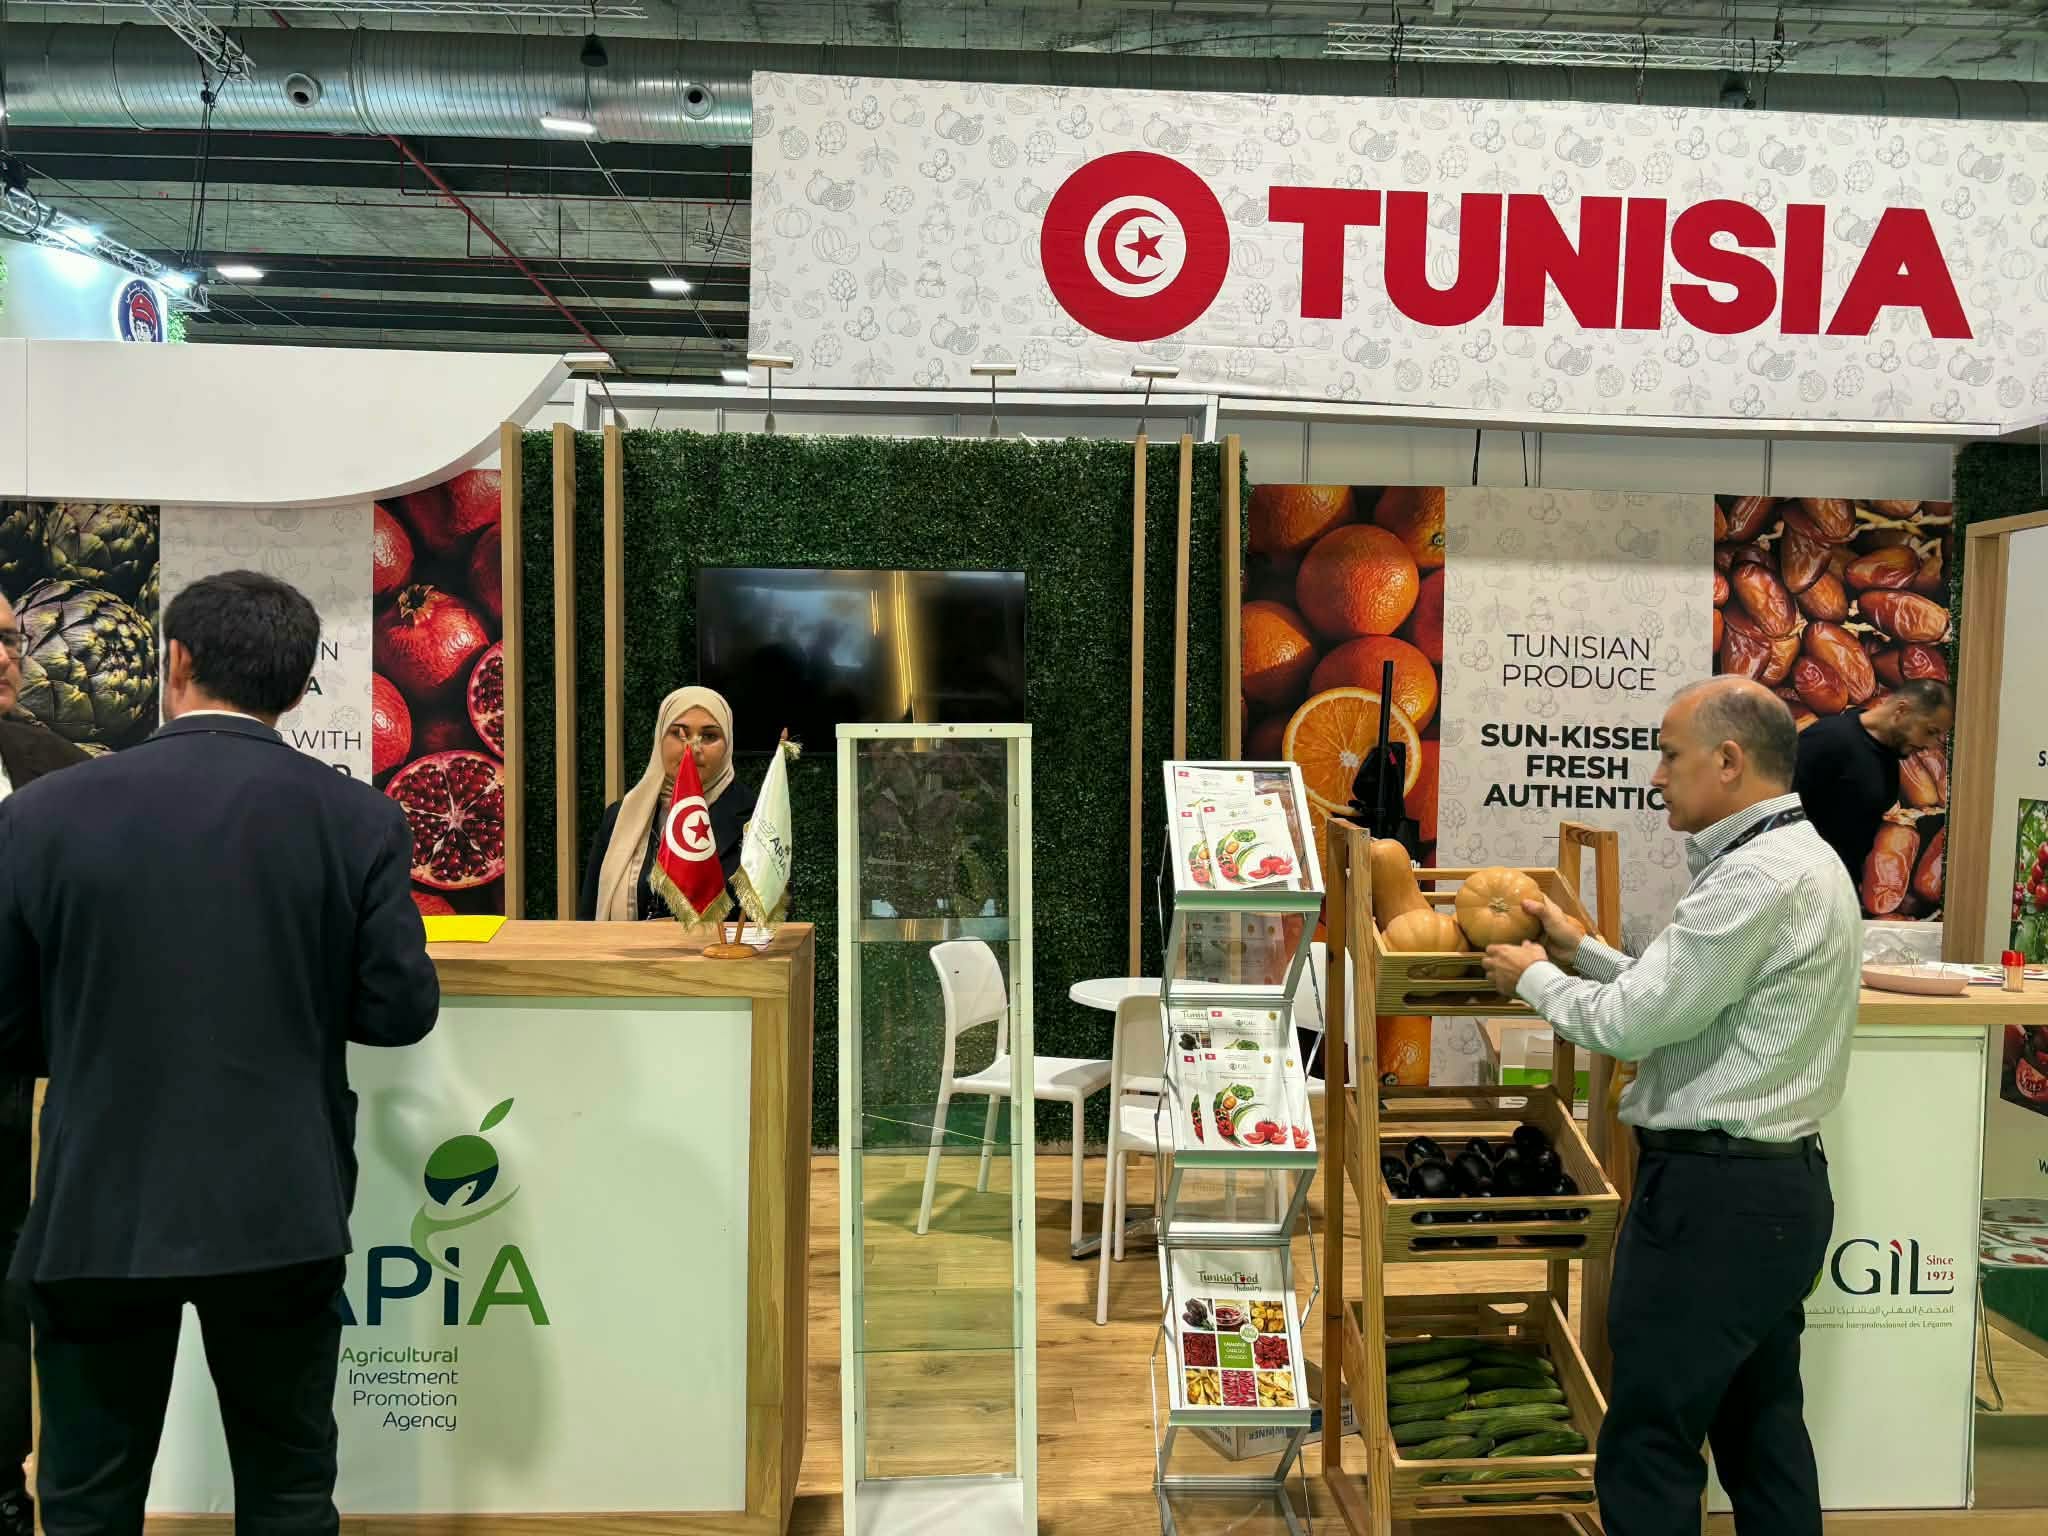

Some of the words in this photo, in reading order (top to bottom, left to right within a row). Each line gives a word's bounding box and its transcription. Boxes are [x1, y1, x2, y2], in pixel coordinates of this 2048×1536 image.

[1268, 185, 1974, 340] TUNISIA
[1506, 633, 1650, 661] TUNISIAN
[1502, 664, 1657, 691] PRODUCE
[291, 729, 362, 751] WITH
[1526, 754, 1629, 780] FRESH
[1483, 783, 1666, 811] AUTHENTIC
[1925, 1254, 1954, 1266] Since
[1197, 1270, 1233, 1283] Tunisia
[1926, 1270, 1954, 1281] 1973
[1909, 1319, 1921, 1329] des
[339, 1346, 459, 1366] Agricultural
[348, 1368, 460, 1385] Investment
[352, 1389, 457, 1407] Promotion
[382, 1410, 457, 1432] Agency
